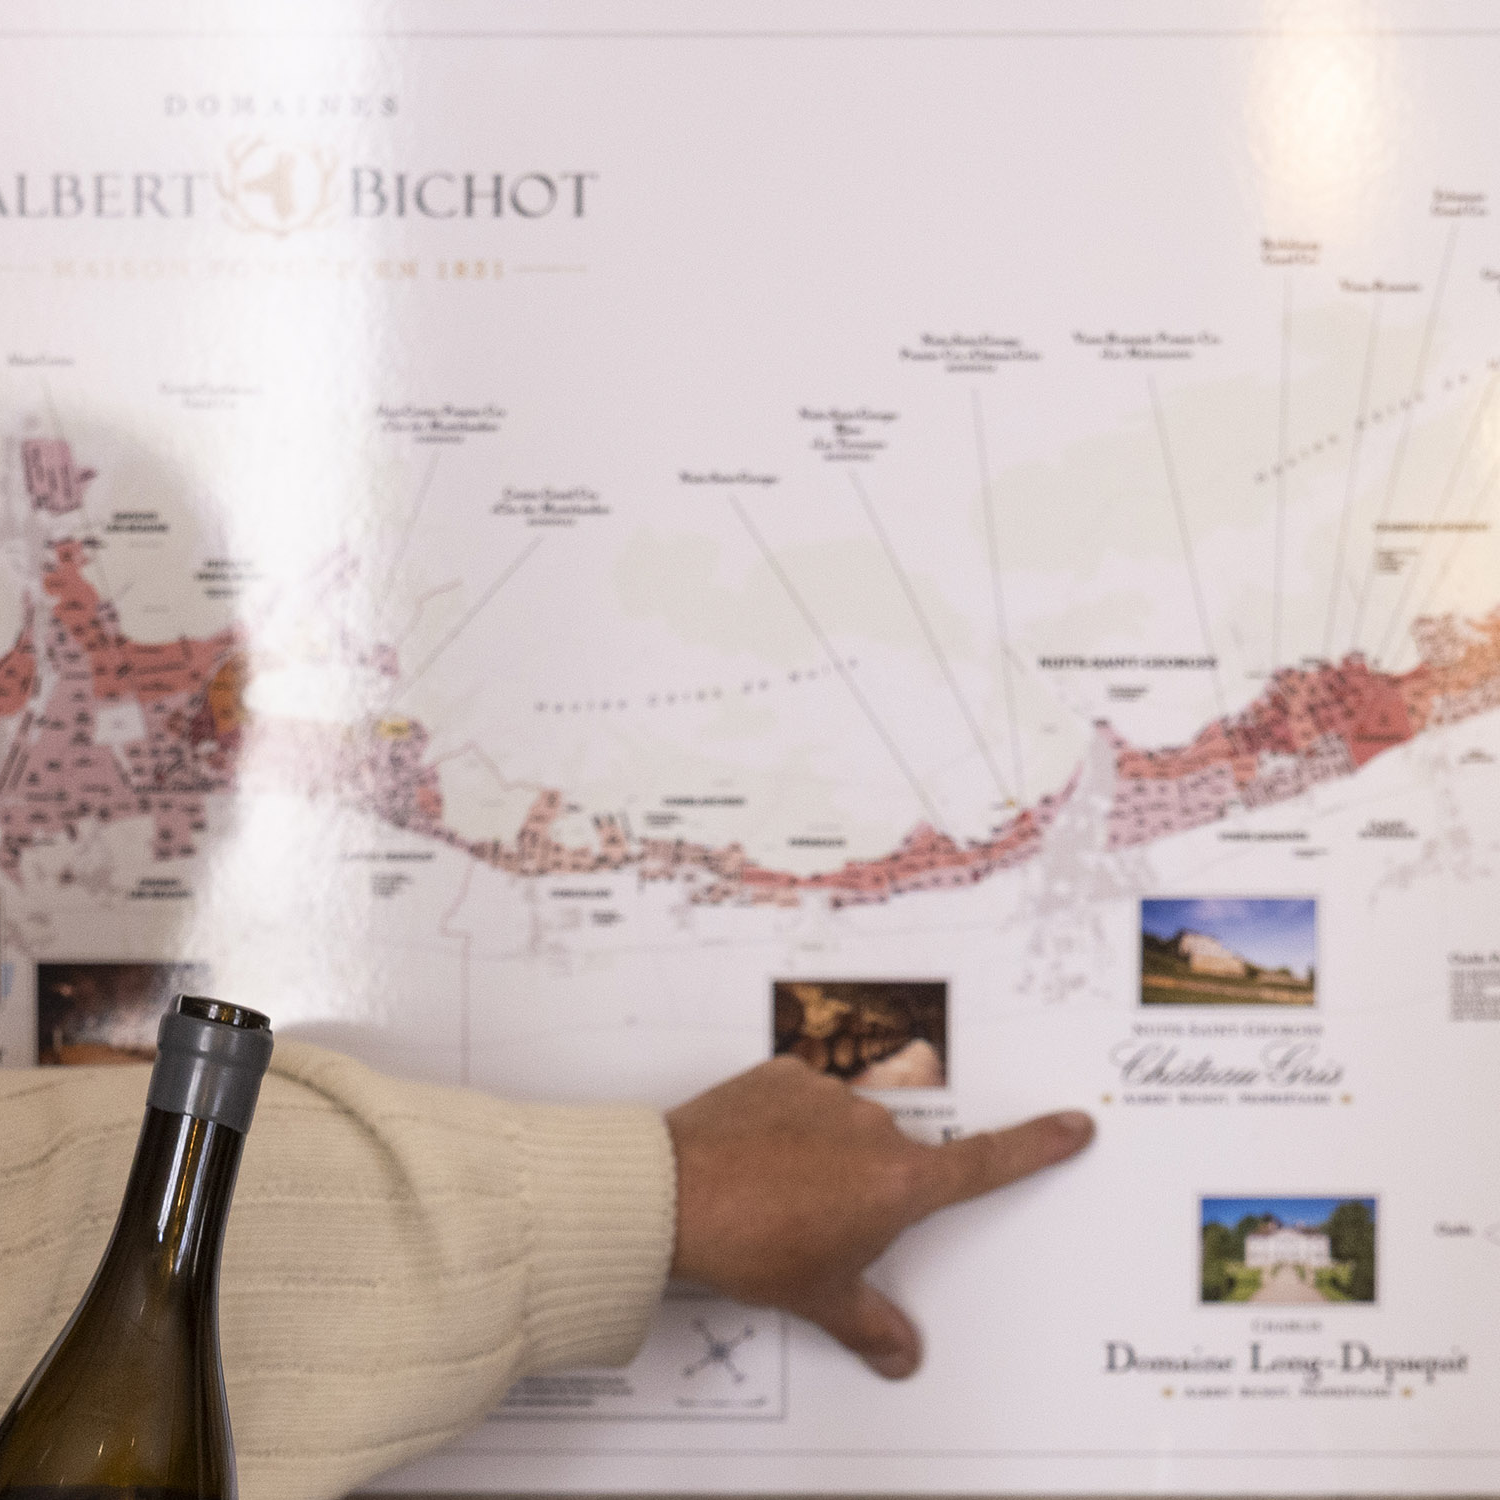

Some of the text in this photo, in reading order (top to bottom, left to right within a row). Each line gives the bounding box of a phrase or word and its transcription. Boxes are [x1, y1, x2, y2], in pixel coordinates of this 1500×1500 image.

[163, 94, 400, 118] DOMAINES
[349, 165, 601, 220] BICHOT
[1108, 1037, 1344, 1086] Château Gris
[1104, 1340, 1235, 1374] Domaine
